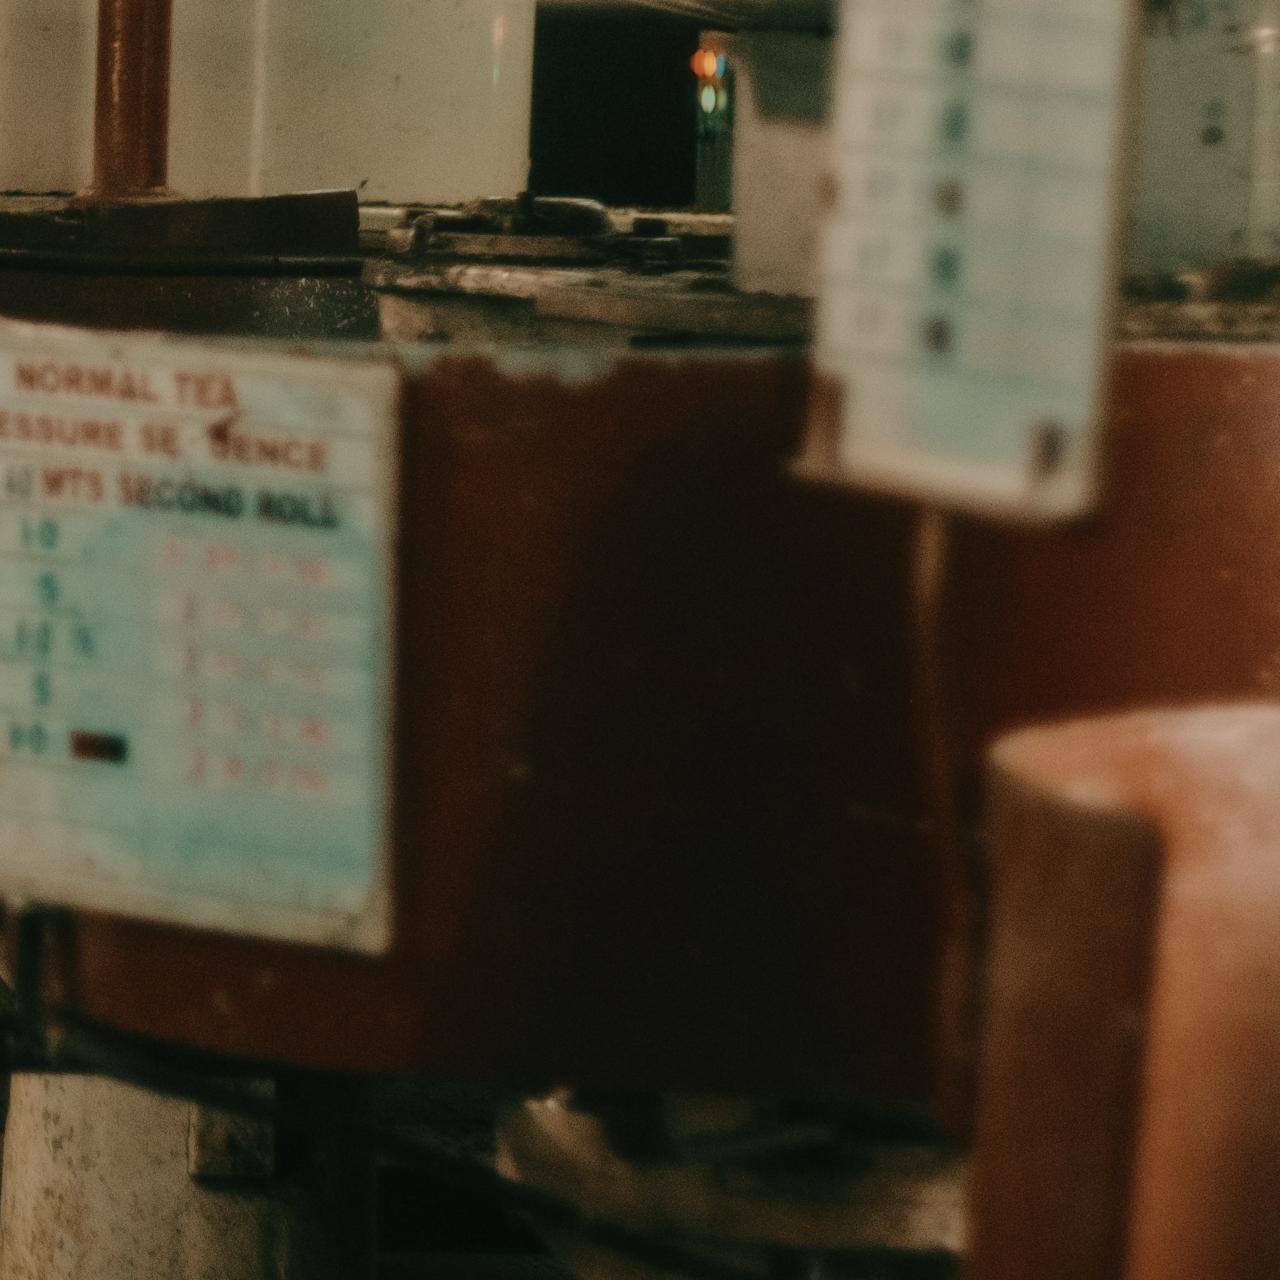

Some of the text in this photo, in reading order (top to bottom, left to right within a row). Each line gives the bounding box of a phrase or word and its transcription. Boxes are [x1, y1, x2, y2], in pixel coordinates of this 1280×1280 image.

[16, 361, 239, 411] NORMAL TEA
[118, 472, 245, 518] SECOND
